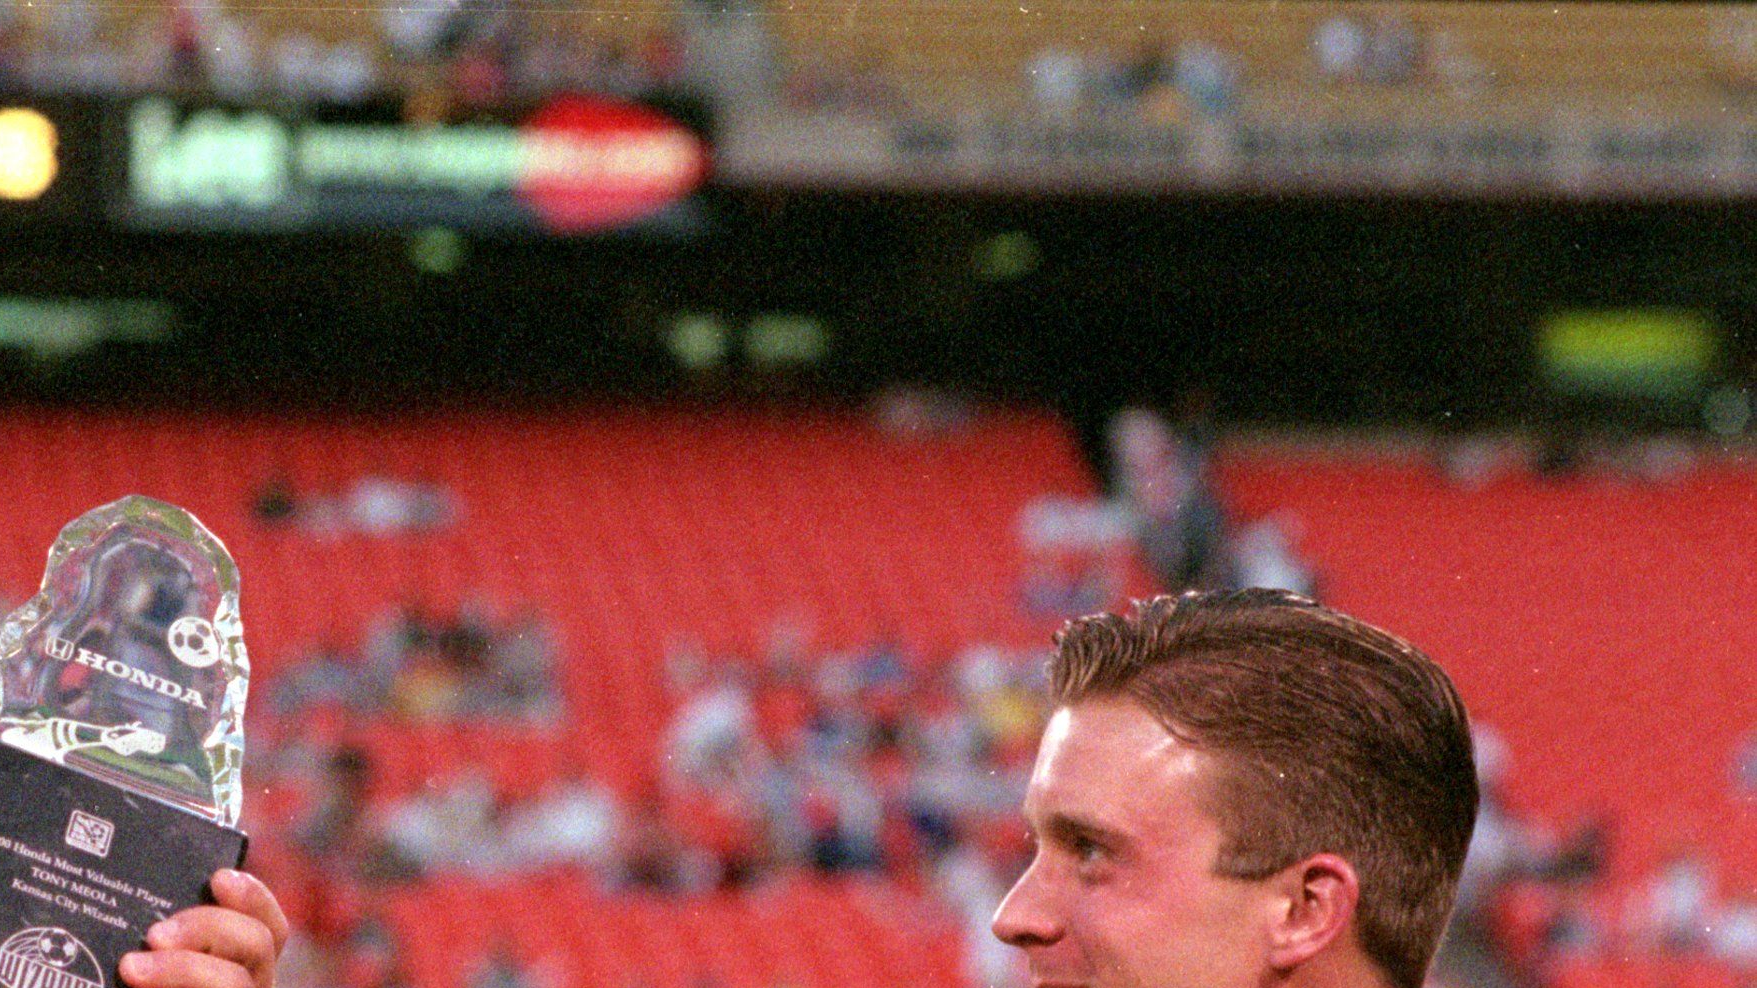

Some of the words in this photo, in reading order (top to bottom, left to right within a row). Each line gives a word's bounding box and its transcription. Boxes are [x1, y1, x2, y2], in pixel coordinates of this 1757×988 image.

[76, 647, 207, 709] HONDA
[12, 878, 53, 901] Kansas
[55, 894, 80, 914] City
[82, 903, 130, 930] Wizards
[13, 842, 52, 865] Honda
[54, 857, 83, 877] Most
[86, 868, 134, 895] Valuable
[136, 887, 173, 910] Player
[31, 866, 69, 888] TONY
[71, 882, 118, 907] MEOLA
